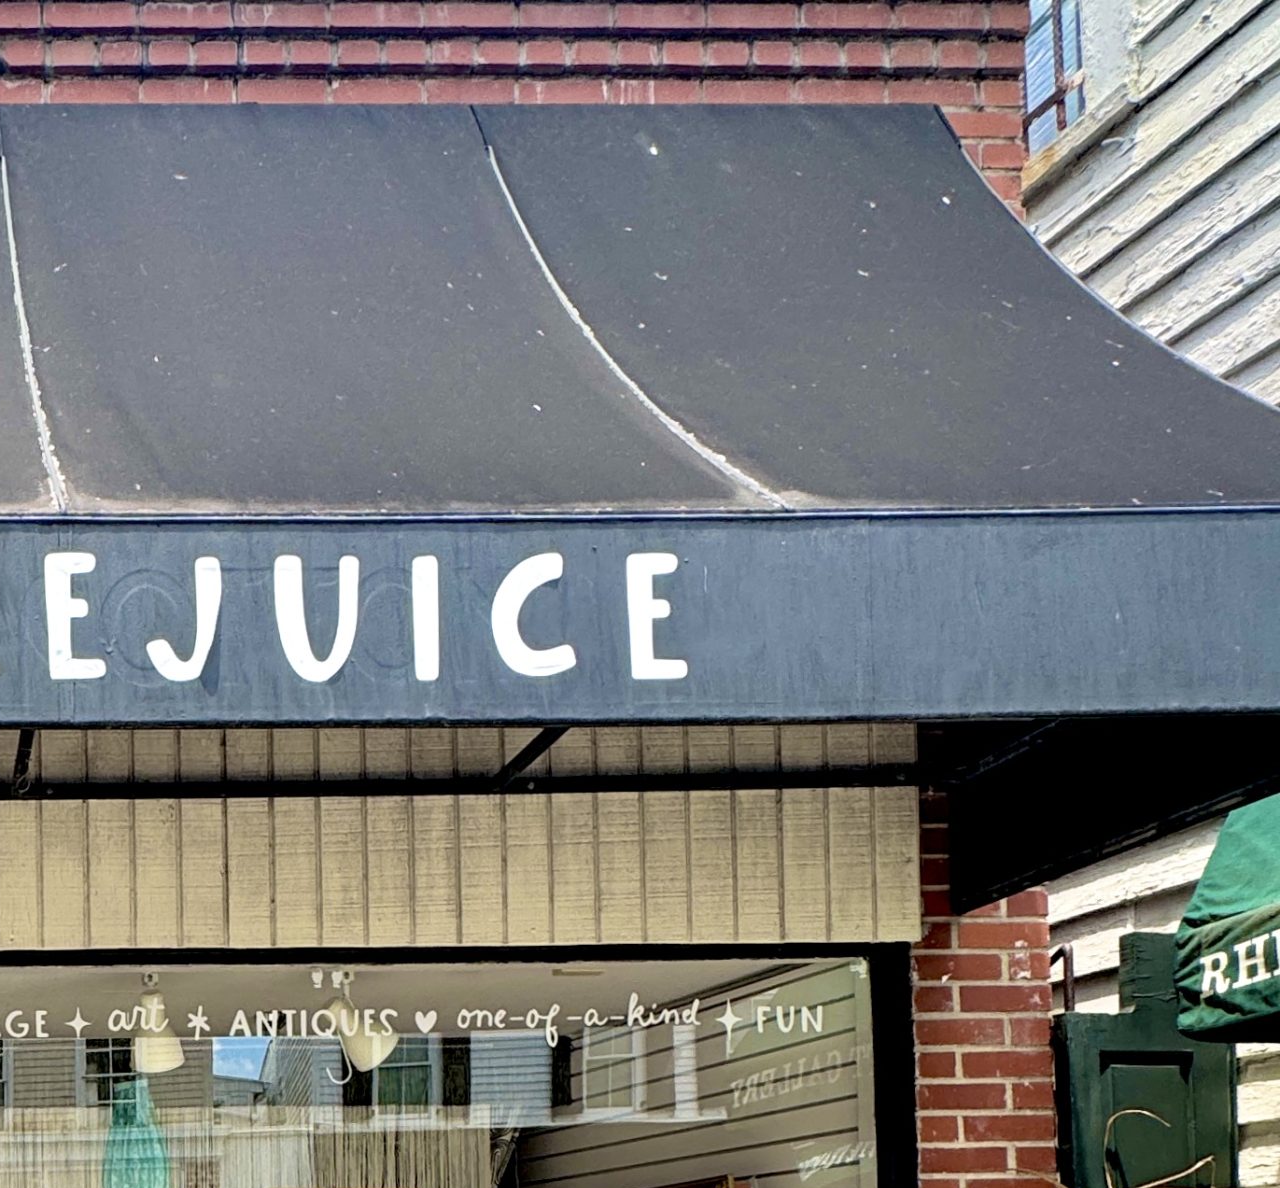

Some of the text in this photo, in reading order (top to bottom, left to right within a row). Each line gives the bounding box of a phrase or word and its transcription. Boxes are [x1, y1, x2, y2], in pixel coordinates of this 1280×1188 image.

[107, 1003, 170, 1034] art
[228, 1008, 398, 1038] ANTIQUES
[456, 992, 701, 1048] one-of-a-kind
[756, 1005, 825, 1033] FUN
